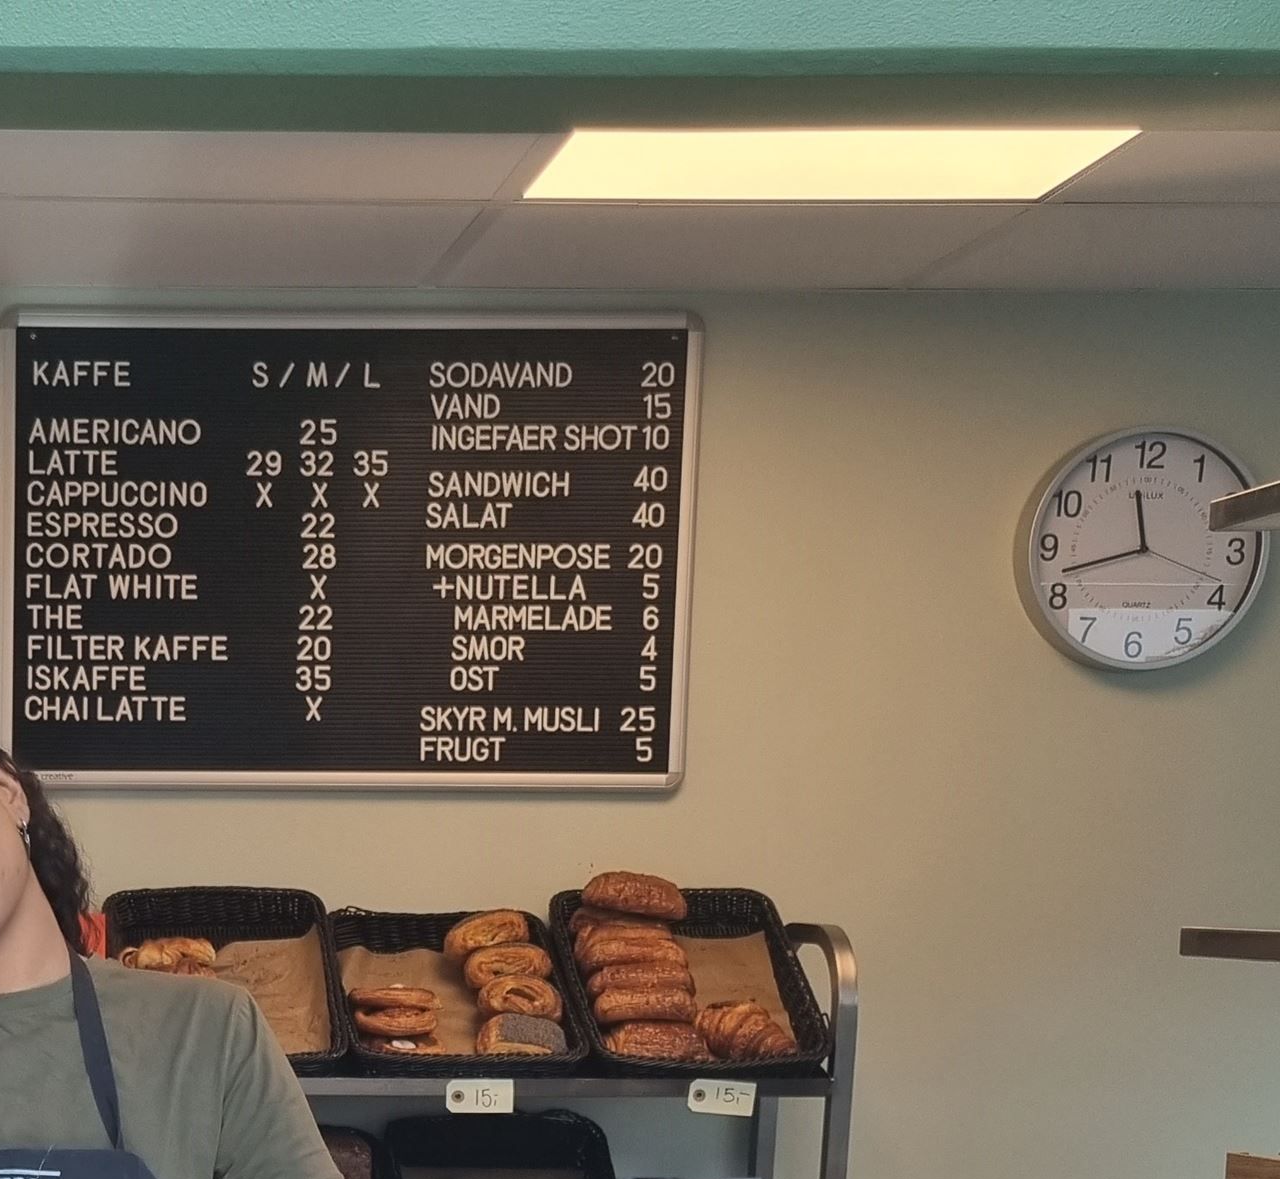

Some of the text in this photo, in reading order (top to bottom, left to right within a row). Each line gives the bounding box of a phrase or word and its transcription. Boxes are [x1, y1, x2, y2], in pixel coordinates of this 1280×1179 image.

[33, 359, 381, 389] KAFFE S M L
[429, 361, 675, 389] SODAVAND 20
[430, 392, 672, 420] VAND 15
[28, 417, 337, 446] AMERICANO 25
[431, 424, 670, 452] INGEFAER SHOT 10
[28, 449, 389, 477] LATTE 29 32 35
[1086, 454, 1112, 483] 11
[1135, 440, 1167, 469] 12
[1193, 454, 1205, 483] 1
[27, 480, 380, 508] CAPPUCCINO X X X
[427, 465, 668, 498] SANDWICH 40
[425, 502, 665, 529] SALAT 40
[1053, 490, 1082, 517] 10
[27, 511, 335, 539] ESPRESSO 22
[26, 542, 337, 570] CORTADO 28
[426, 542, 663, 570] MORGENPOSE 20
[1040, 534, 1058, 561] 9
[1226, 538, 1245, 565] 3
[25, 573, 328, 600] FLAT WHITE X
[432, 573, 661, 601] +NUTELLA 5
[1048, 583, 1067, 610] 8
[1207, 584, 1226, 611] 4
[26, 604, 333, 631] THE 22
[454, 604, 659, 632] MARMELADE 6
[1122, 601, 1152, 609] QUARTZ
[1079, 617, 1097, 643] 7
[1174, 617, 1192, 645] 5
[27, 634, 331, 662] FILTER KAFFE 20
[451, 634, 658, 661] SMOR 4
[1124, 632, 1142, 658] 6
[27, 665, 331, 692] ISKAFFE 35
[450, 665, 657, 692] OST 5
[24, 695, 323, 722] CHAI LATTE X
[419, 705, 656, 732] SKYR M. MUSLI 25
[420, 736, 653, 762] FRUGT 5
